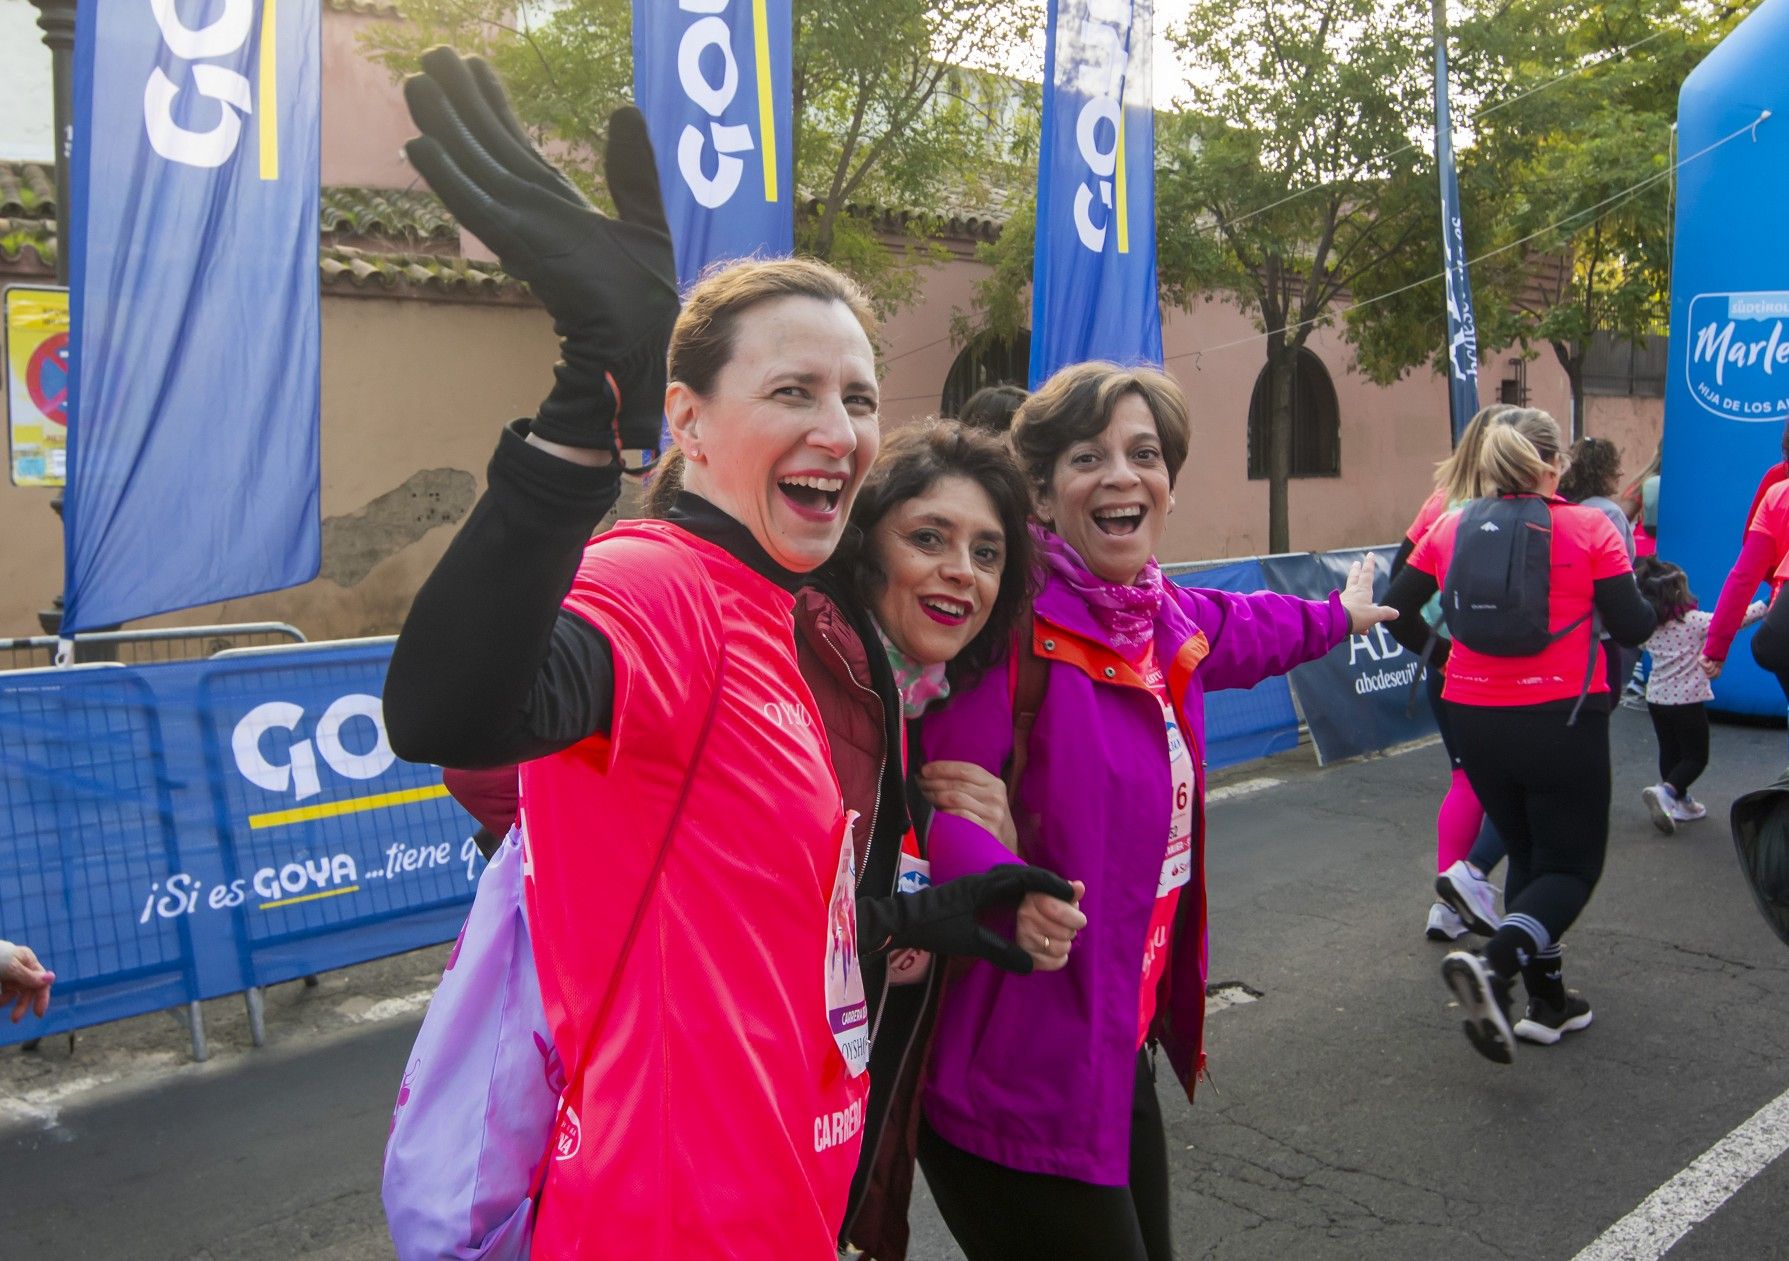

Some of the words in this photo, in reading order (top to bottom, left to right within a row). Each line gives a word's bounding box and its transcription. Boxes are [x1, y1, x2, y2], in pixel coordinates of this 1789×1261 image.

[677, 0, 755, 209] GO
[1698, 382, 1720, 405] HIJA
[1722, 398, 1741, 411] DE
[1744, 401, 1772, 413] LOS
[1776, 399, 1789, 412] A
[231, 693, 439, 801] GO
[208, 879, 246, 909] es
[252, 853, 357, 899] GOYA
[460, 836, 484, 881] q
